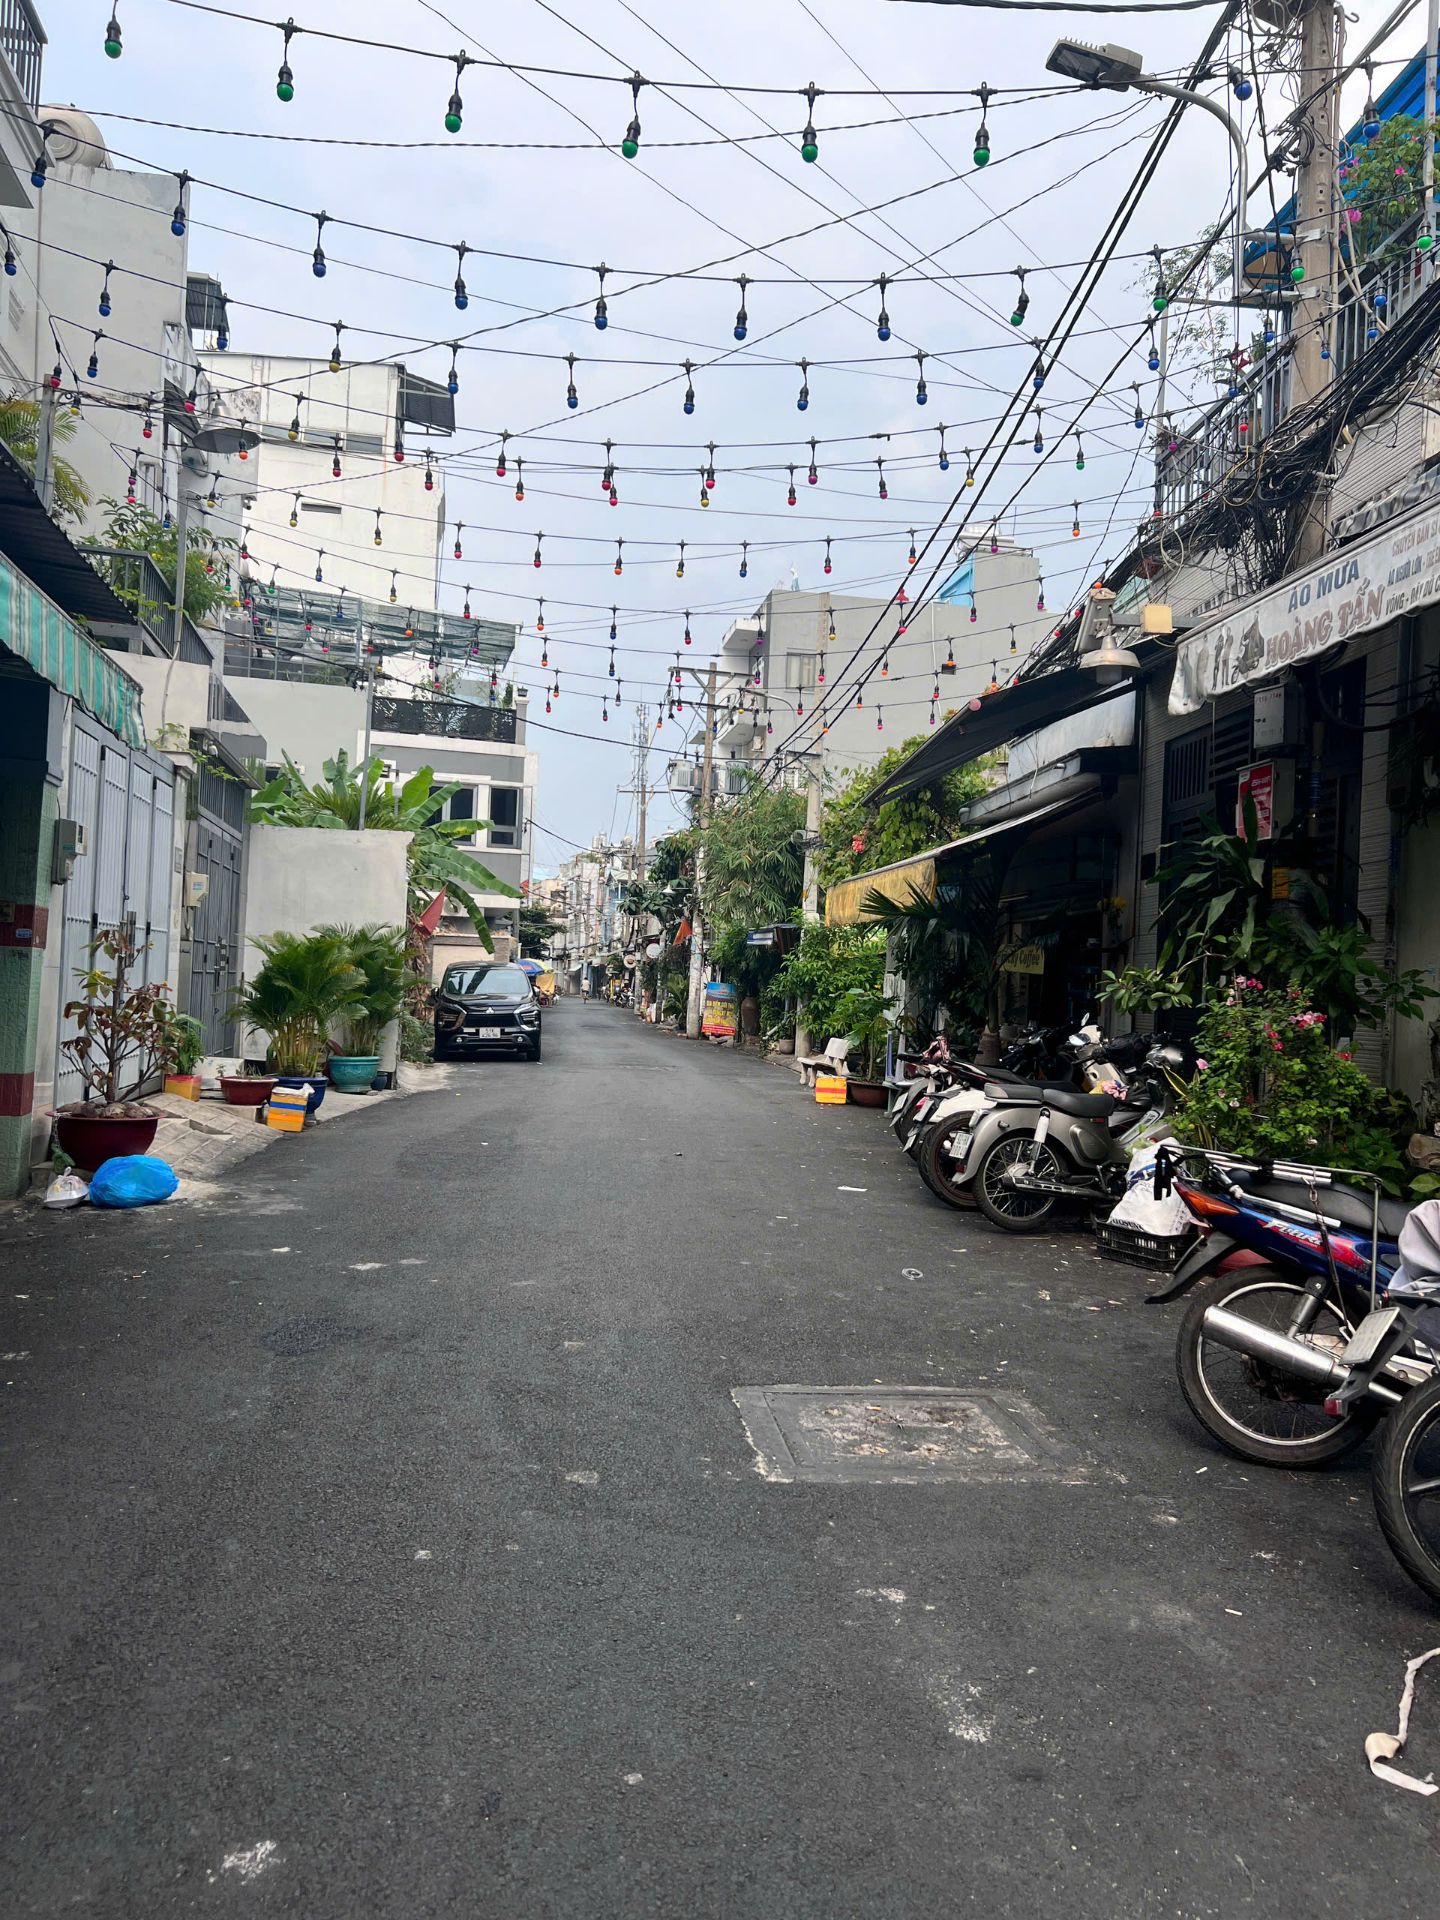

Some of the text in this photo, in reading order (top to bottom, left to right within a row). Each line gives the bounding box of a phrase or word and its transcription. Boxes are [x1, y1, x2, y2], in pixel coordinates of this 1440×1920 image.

[1264, 577, 1386, 670] HOÀNG TẤN
[1288, 559, 1360, 614] ÁO MƯA
